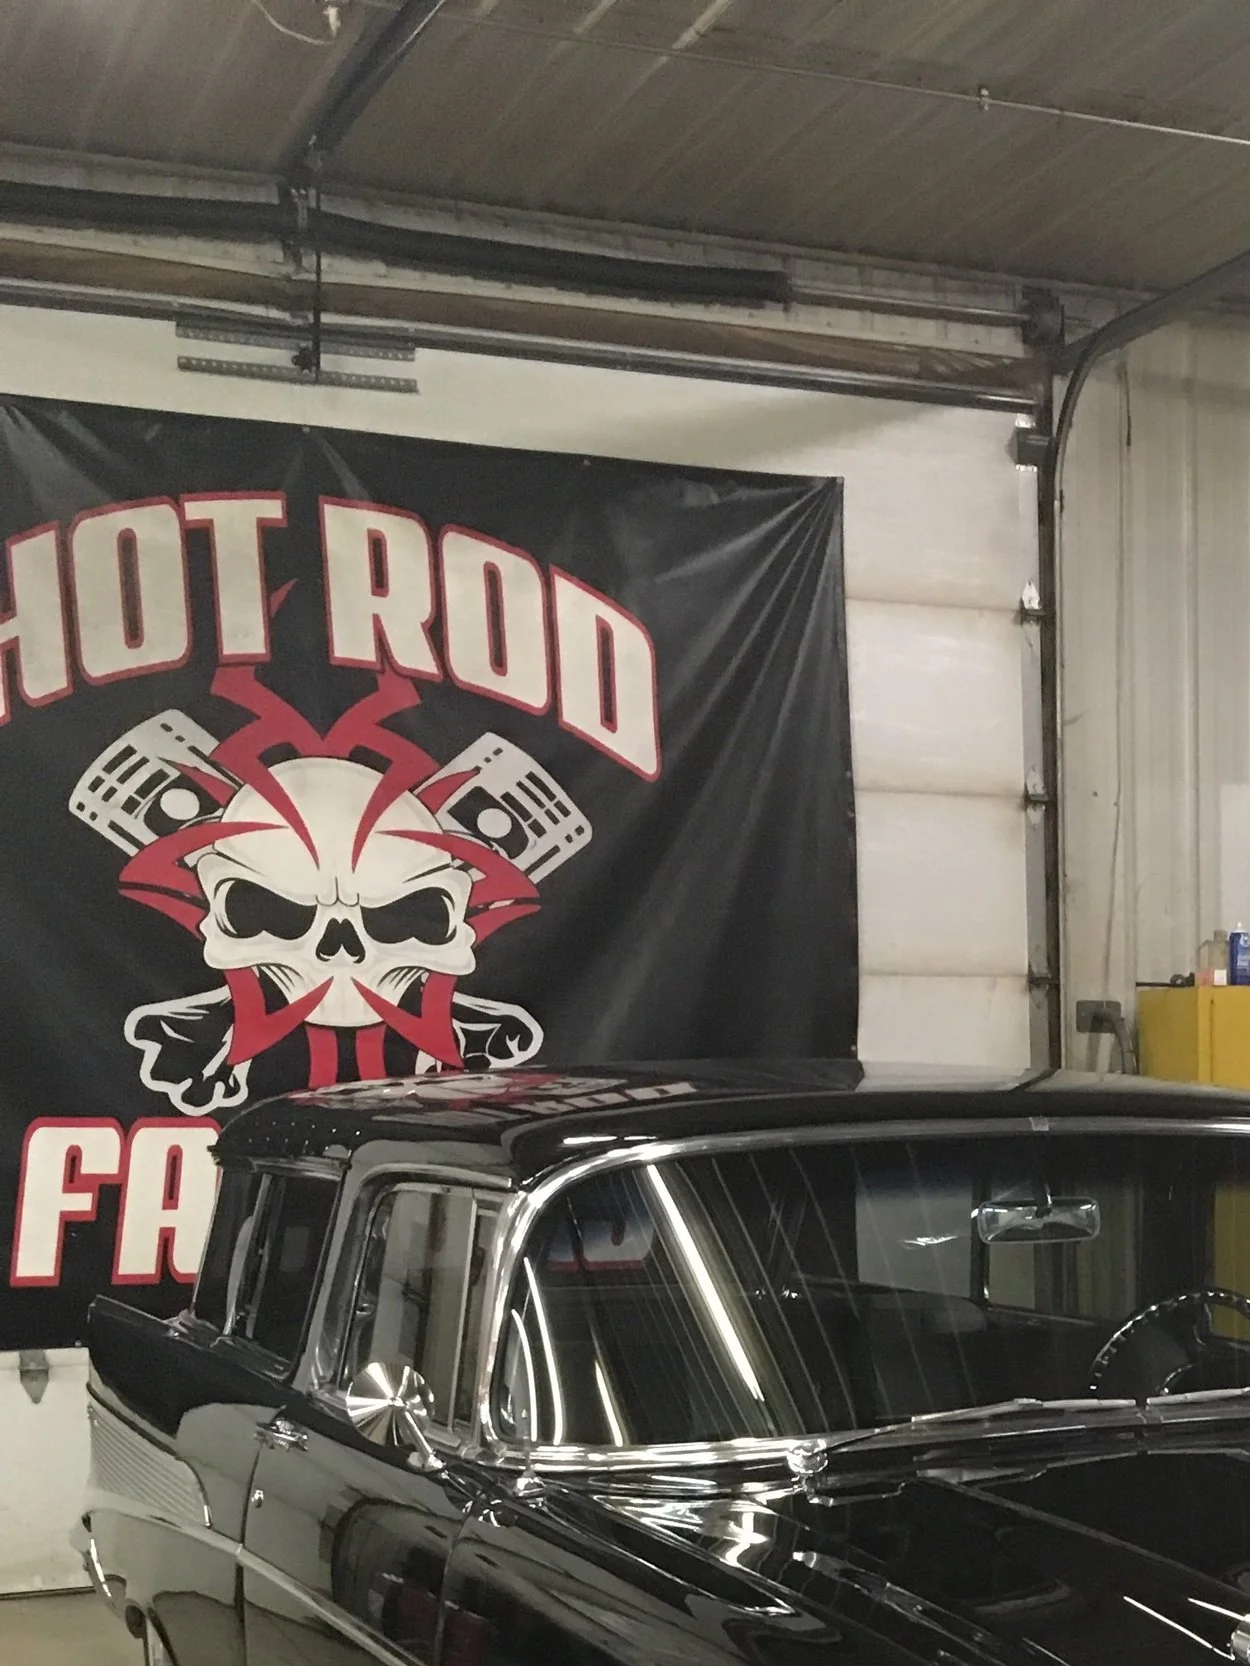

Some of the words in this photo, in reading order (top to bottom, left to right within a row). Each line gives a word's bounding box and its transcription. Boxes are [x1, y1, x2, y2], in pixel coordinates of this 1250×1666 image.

[0, 489, 288, 727] HOT
[318, 494, 662, 783] ROD
[9, 1116, 224, 1288] FA
